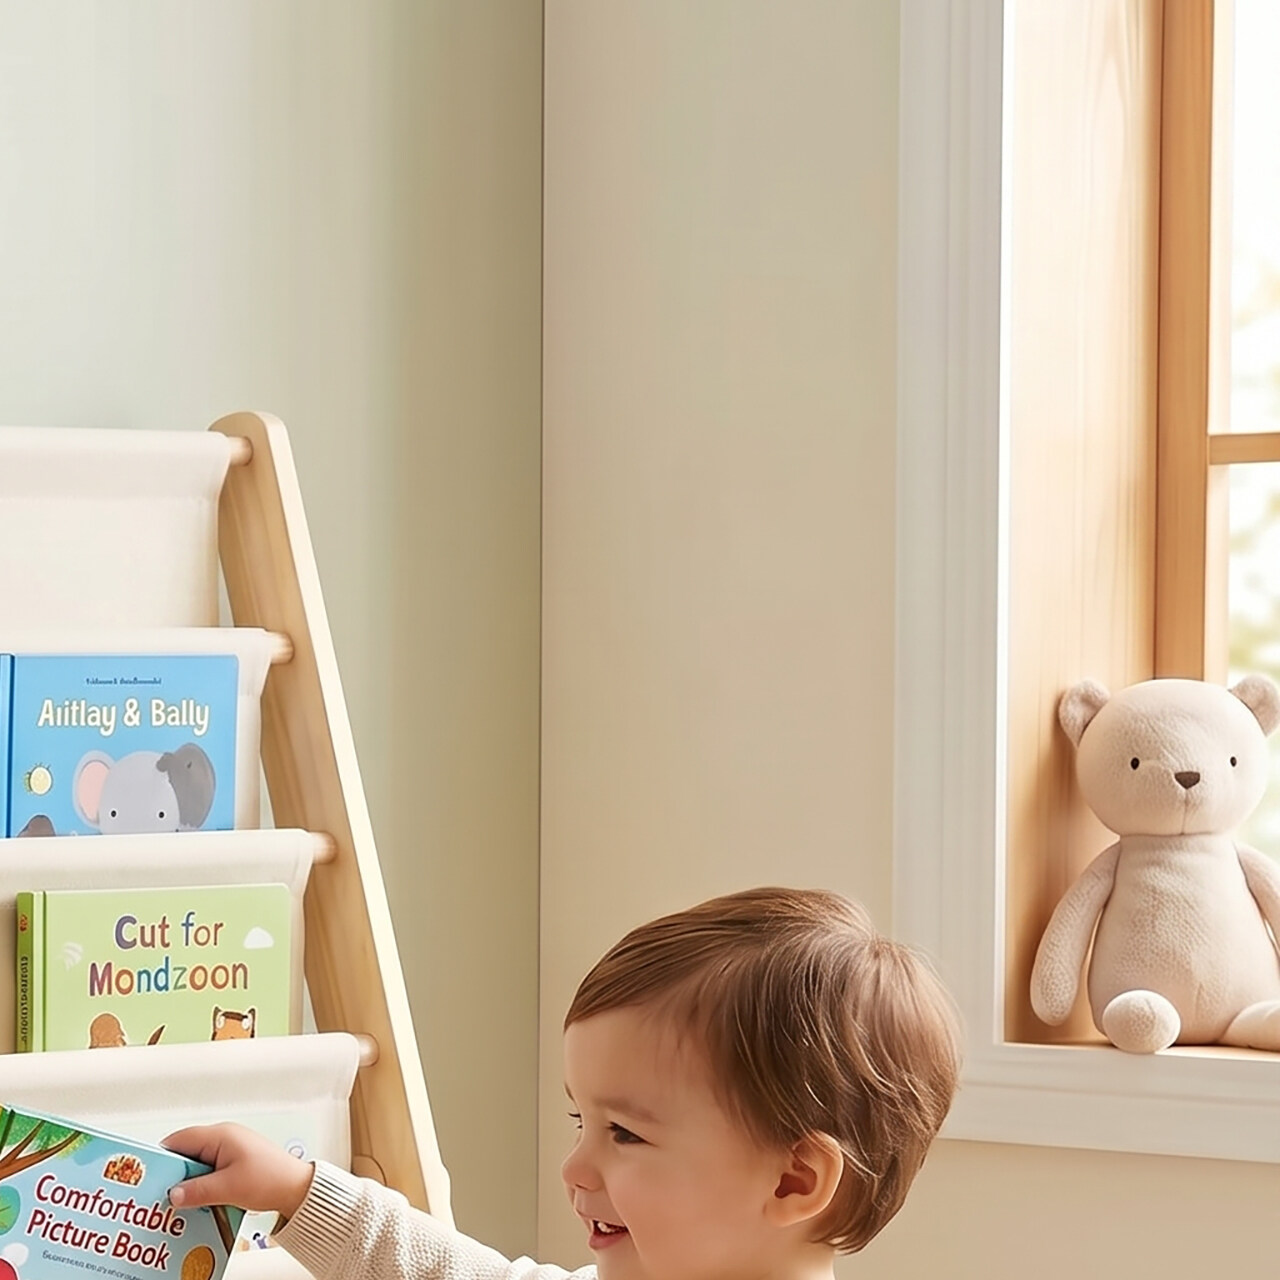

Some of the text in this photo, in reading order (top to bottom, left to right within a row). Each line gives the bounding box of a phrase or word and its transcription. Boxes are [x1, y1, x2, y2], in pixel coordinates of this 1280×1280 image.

[123, 697, 141, 727] &
[151, 699, 210, 737] Bally
[114, 911, 224, 950] Cut for
[89, 955, 249, 997] Mondzoon
[36, 1174, 186, 1237] Comfortable
[26, 1208, 110, 1254] Picture
[111, 1231, 171, 1271] Book
